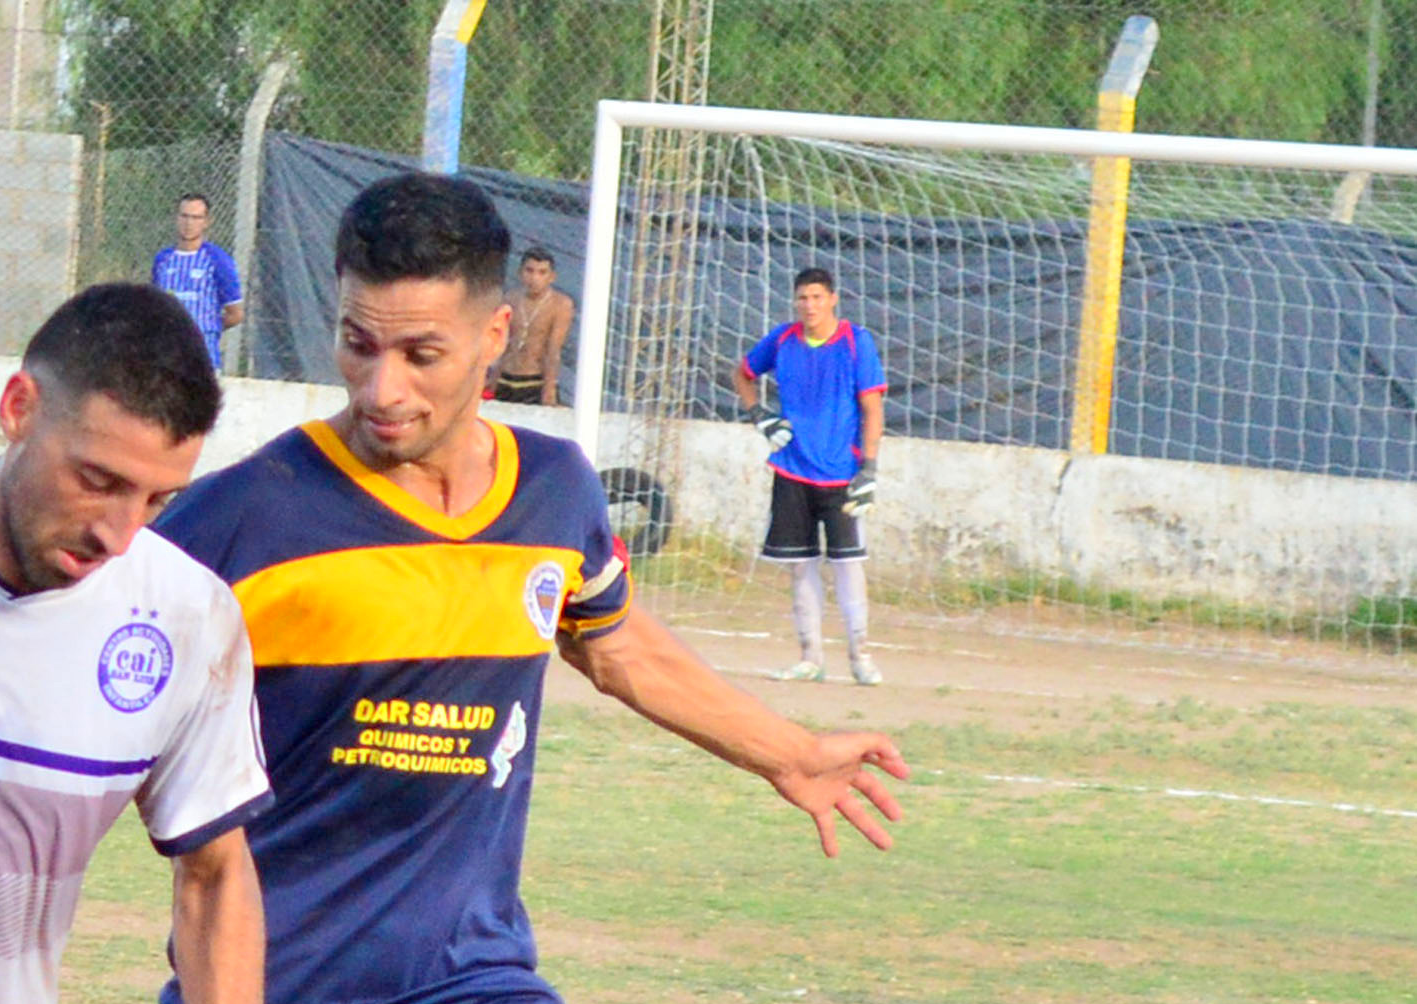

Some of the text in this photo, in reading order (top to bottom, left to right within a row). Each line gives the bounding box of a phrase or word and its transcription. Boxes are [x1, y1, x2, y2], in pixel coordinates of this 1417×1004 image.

[116, 648, 157, 673] cai
[354, 698, 496, 730] DAR SALUD
[359, 729, 471, 754] QUIMICOS Y
[332, 747, 488, 775] PETROQUIMICOS
